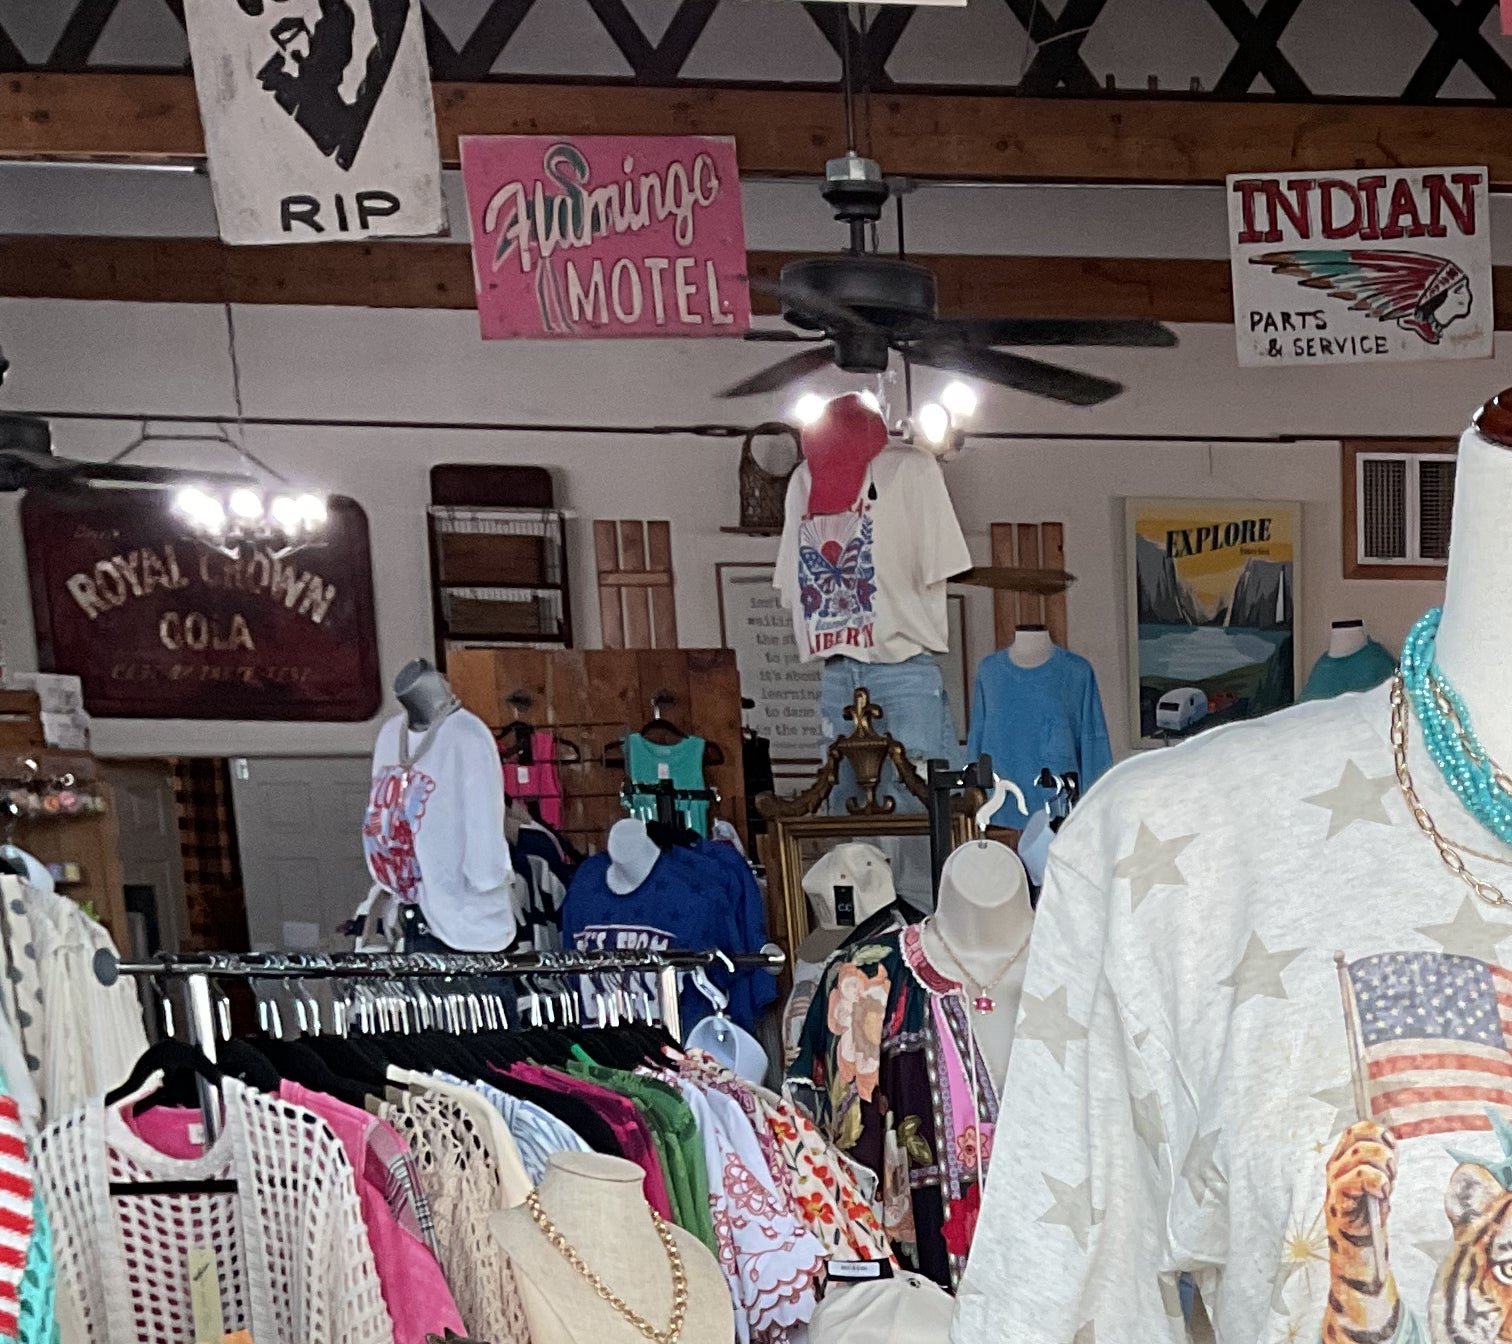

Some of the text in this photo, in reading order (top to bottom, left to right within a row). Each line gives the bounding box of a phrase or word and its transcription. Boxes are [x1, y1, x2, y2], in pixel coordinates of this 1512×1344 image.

[280, 190, 400, 233] RIP
[486, 151, 719, 272] Flamingo
[1233, 173, 1483, 244] INDIAN
[566, 257, 734, 325] MOTEL
[1250, 309, 1328, 333] PARTS
[1267, 335, 1389, 358] & SERVICE
[1166, 518, 1272, 559] EXPLORE
[65, 544, 337, 624] ROYAL CROWN
[159, 610, 256, 651] COLA
